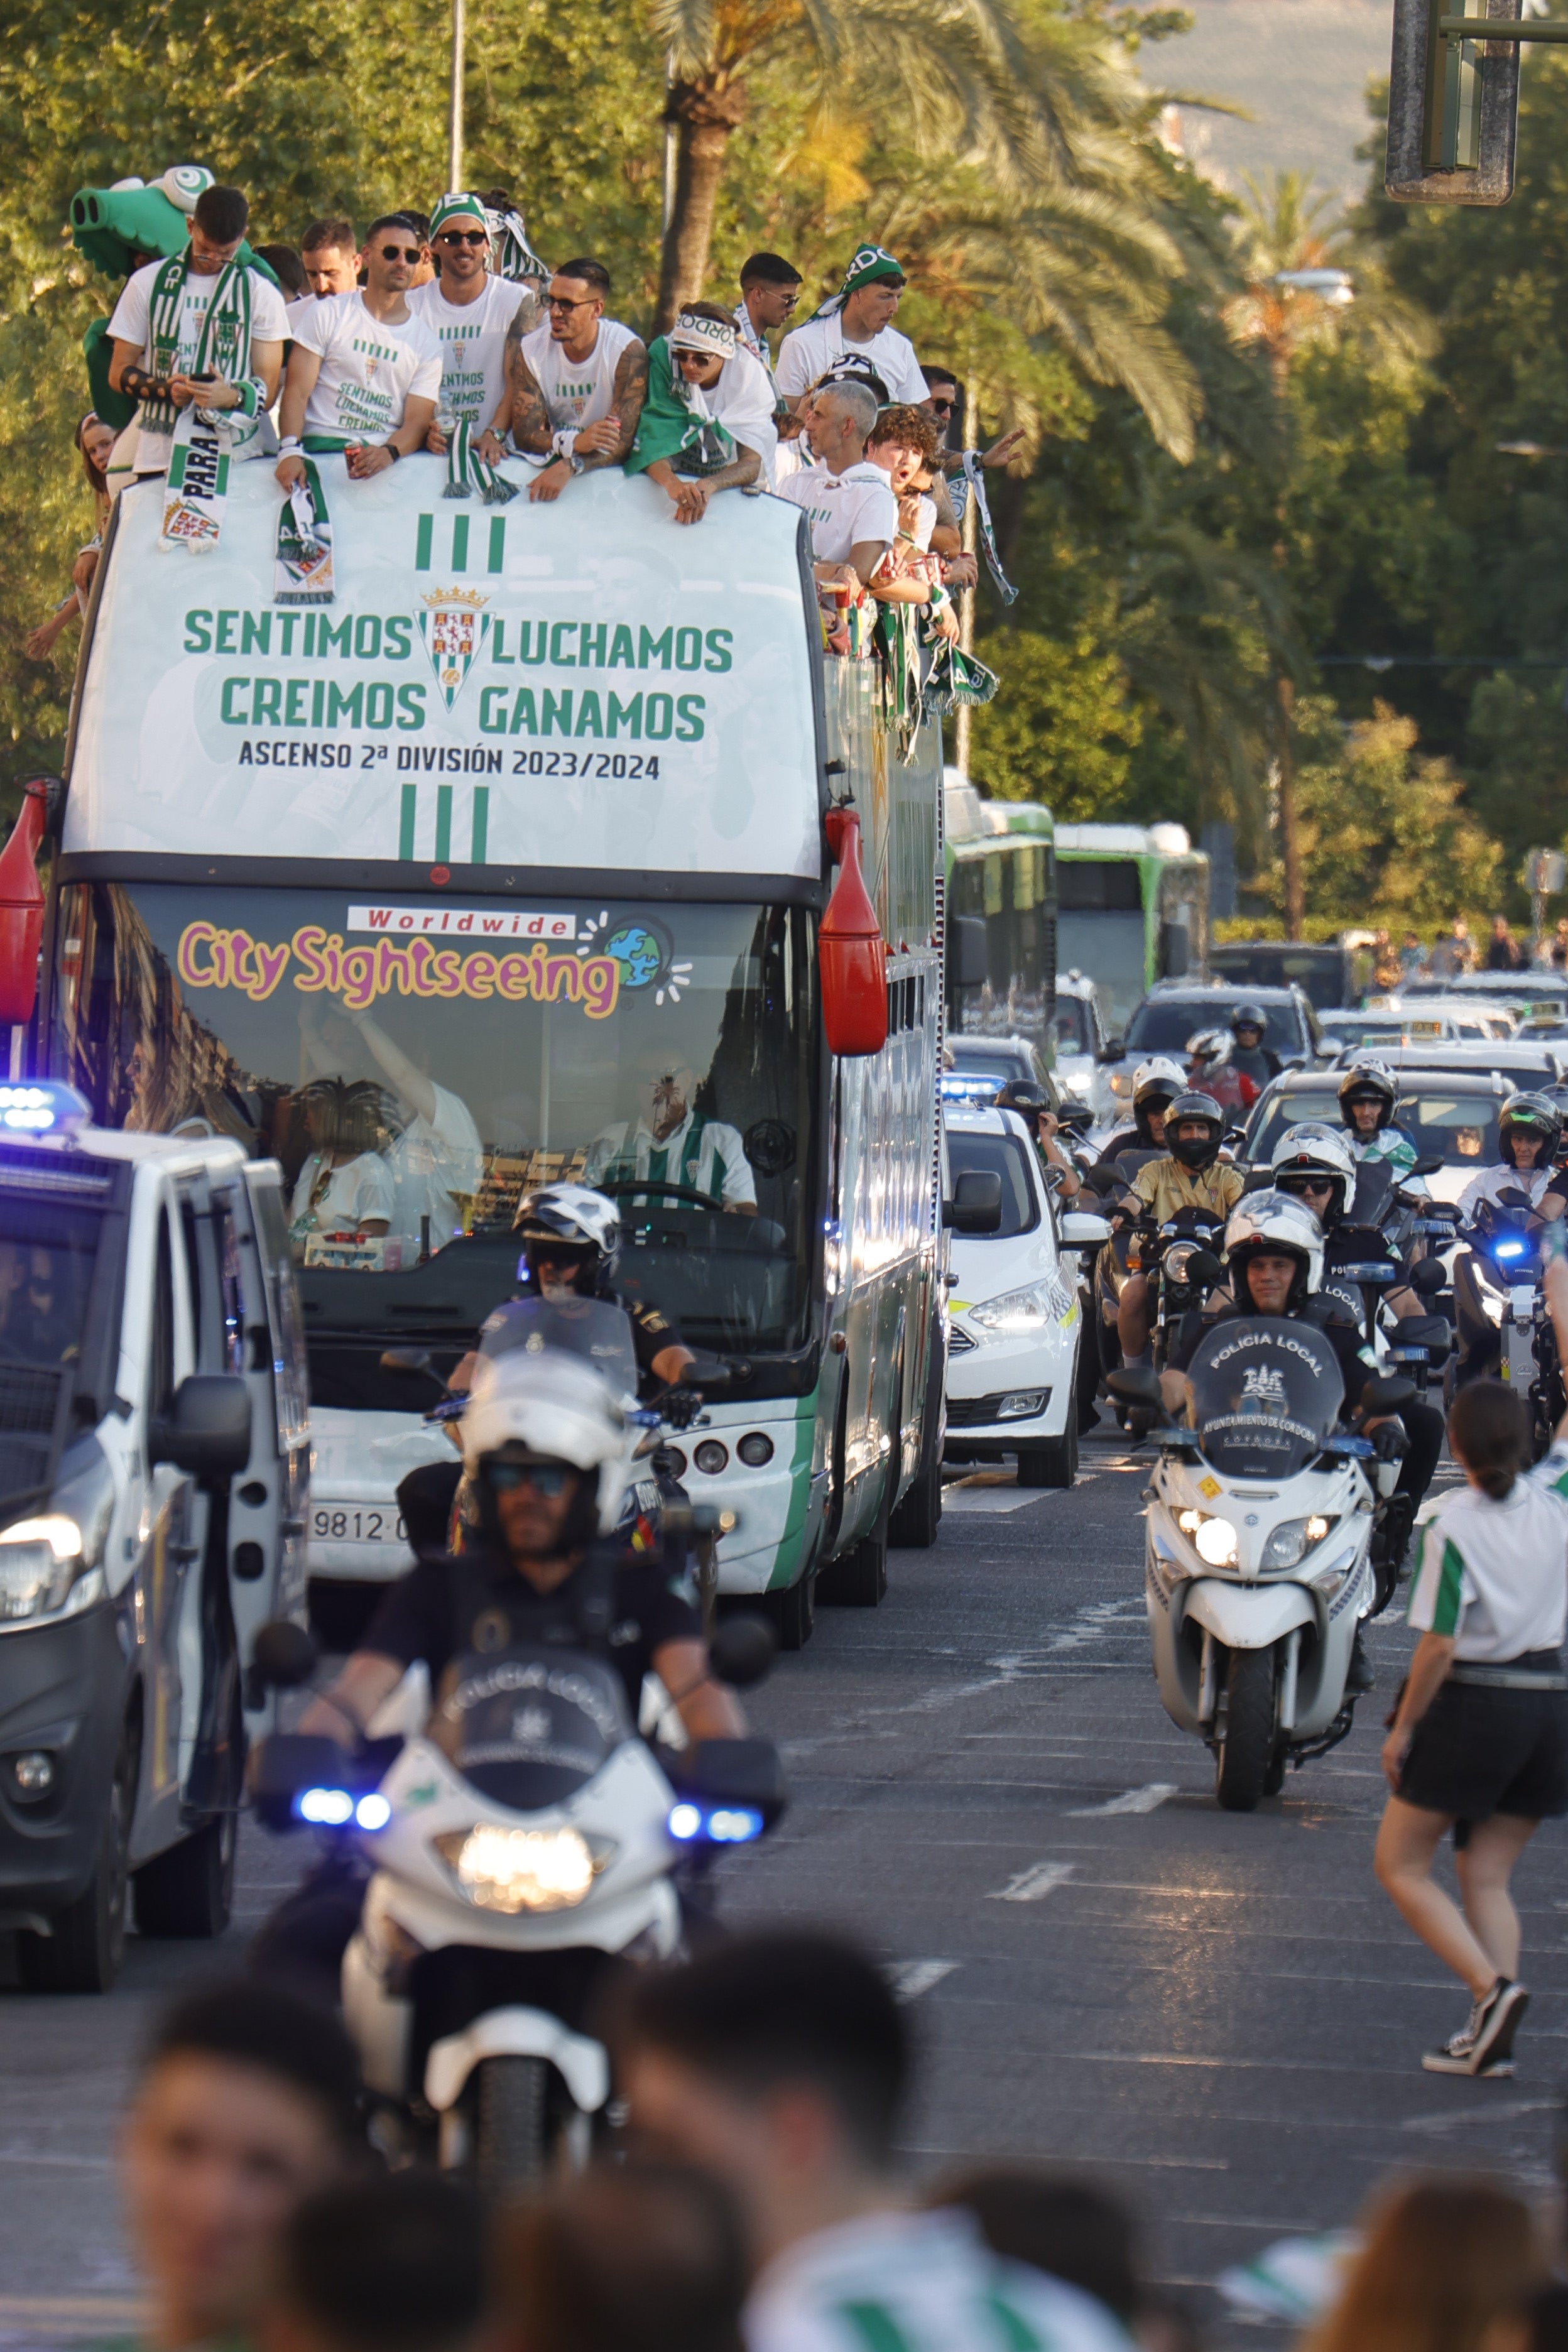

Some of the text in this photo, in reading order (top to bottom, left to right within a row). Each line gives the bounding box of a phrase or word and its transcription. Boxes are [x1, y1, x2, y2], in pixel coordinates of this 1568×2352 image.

[338, 382, 393, 408] SENTIMOS
[182, 437, 219, 500] PARA
[184, 609, 732, 672] SENTIMOS LUCHAMOS
[220, 677, 705, 742] CREIMOS GANAMOS
[239, 741, 352, 769] ASCENSO
[396, 743, 503, 774] DIVISIÓN
[512, 750, 660, 781] 2023/2024
[369, 909, 567, 935] Worldwide
[178, 920, 620, 1020] City Sightseeing
[1326, 1284, 1361, 1316] LOCAL
[1210, 1331, 1323, 1378] POLICIA LOCAL
[1202, 1413, 1268, 1435] AYUNTAMIENTO
[1268, 1416, 1279, 1428] DE
[315, 1511, 383, 1541] 9812
